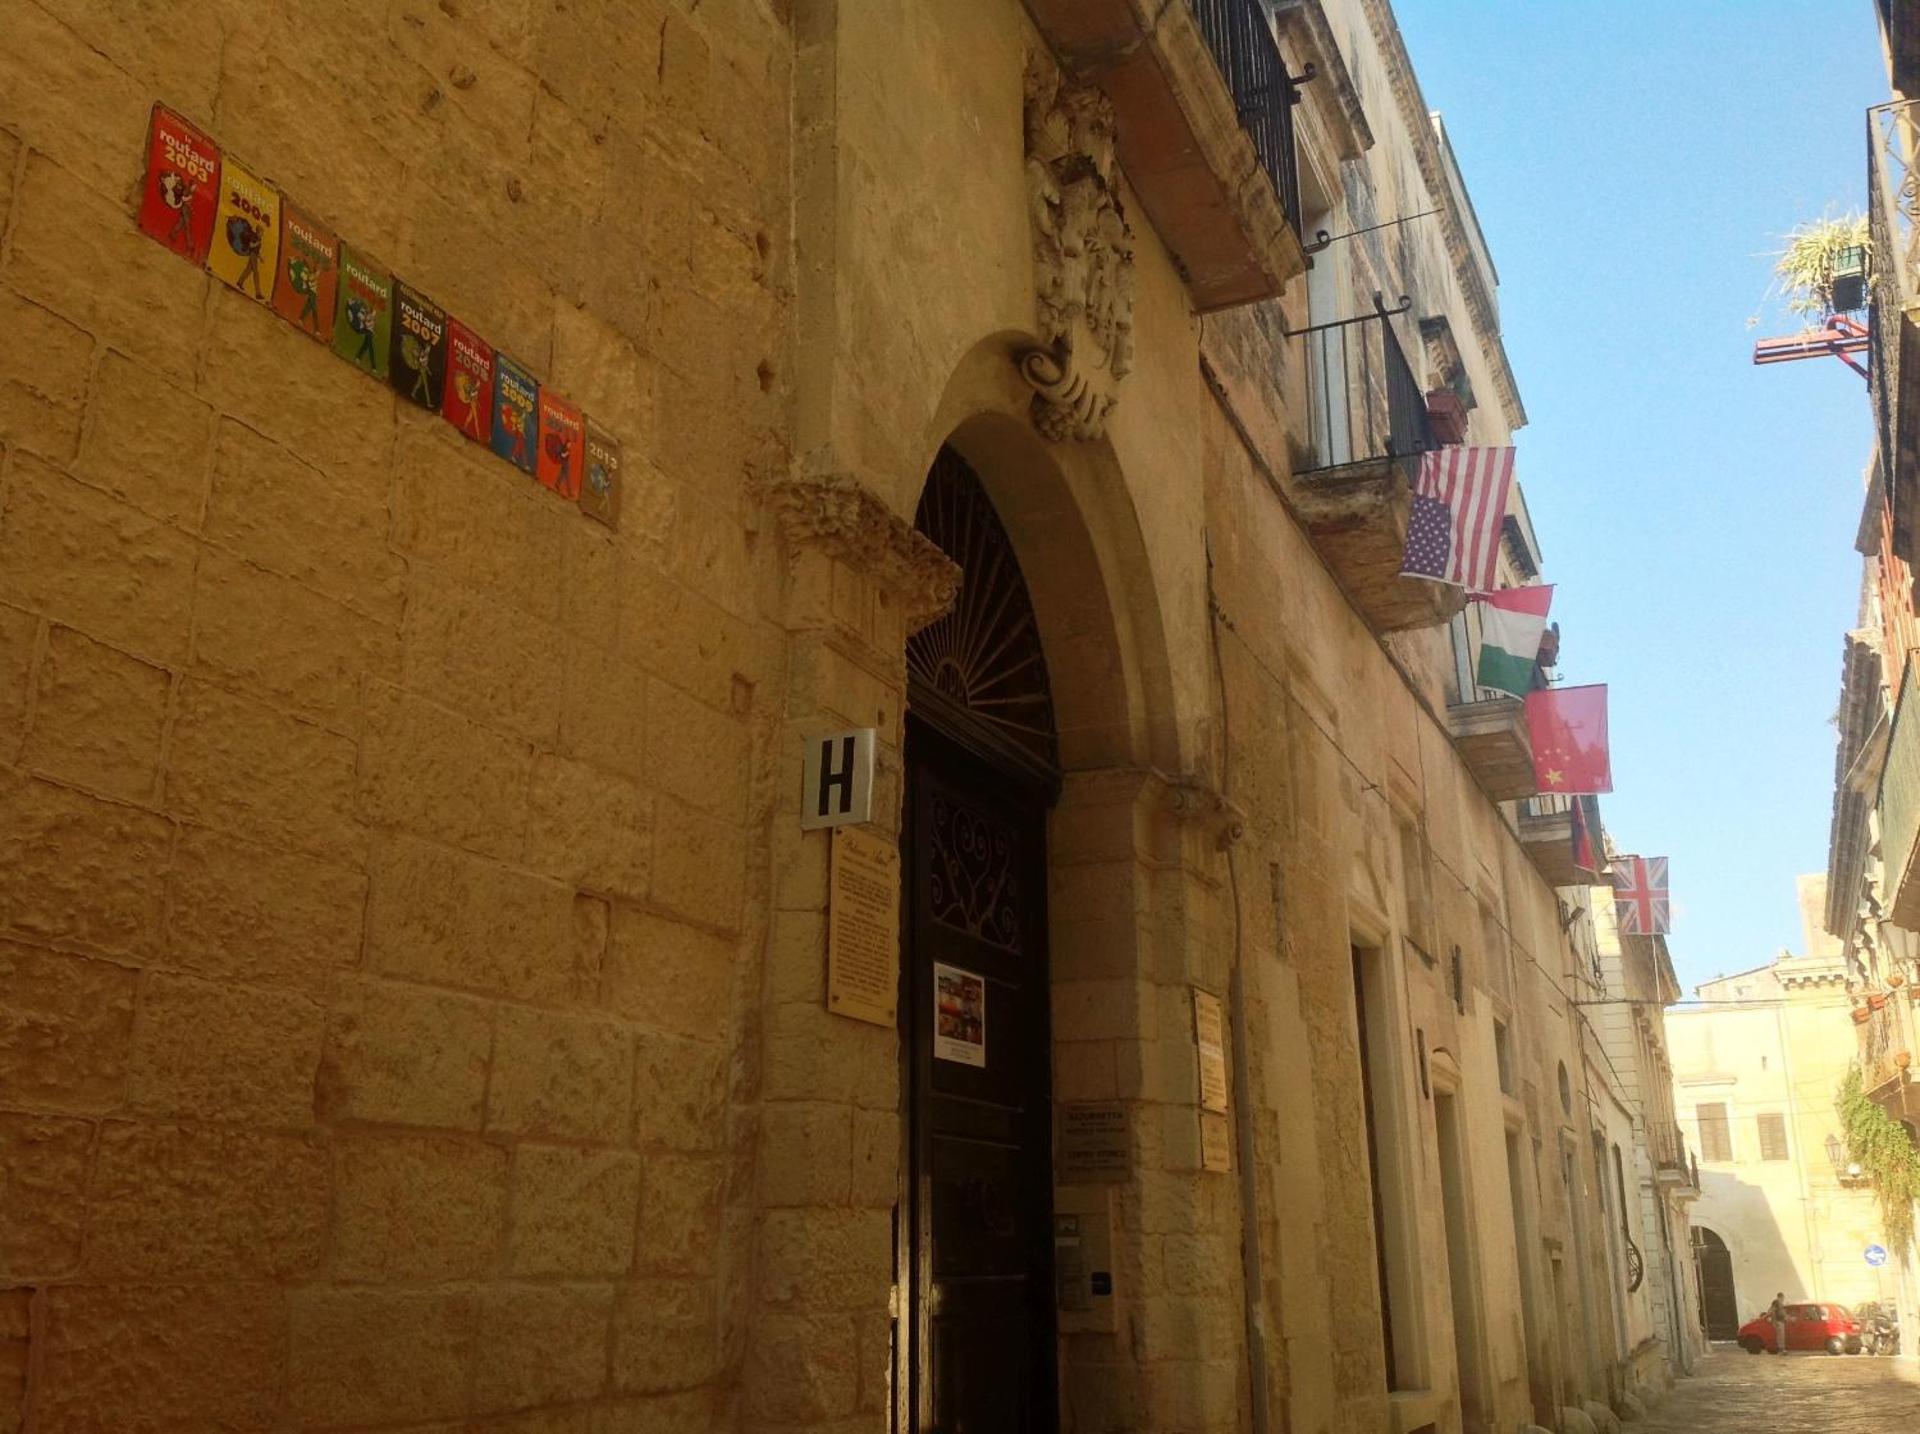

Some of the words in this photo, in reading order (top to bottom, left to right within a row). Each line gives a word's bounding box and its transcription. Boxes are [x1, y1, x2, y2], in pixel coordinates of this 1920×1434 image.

[160, 130, 215, 173] routard
[164, 145, 208, 183] 2003
[288, 220, 332, 258] routard
[346, 263, 387, 298] routard
[399, 313, 440, 346] 2007
[400, 302, 441, 335] routard
[453, 338, 490, 370] routard
[501, 371, 535, 402] routard
[543, 404, 579, 432] routard
[818, 736, 856, 817] H
